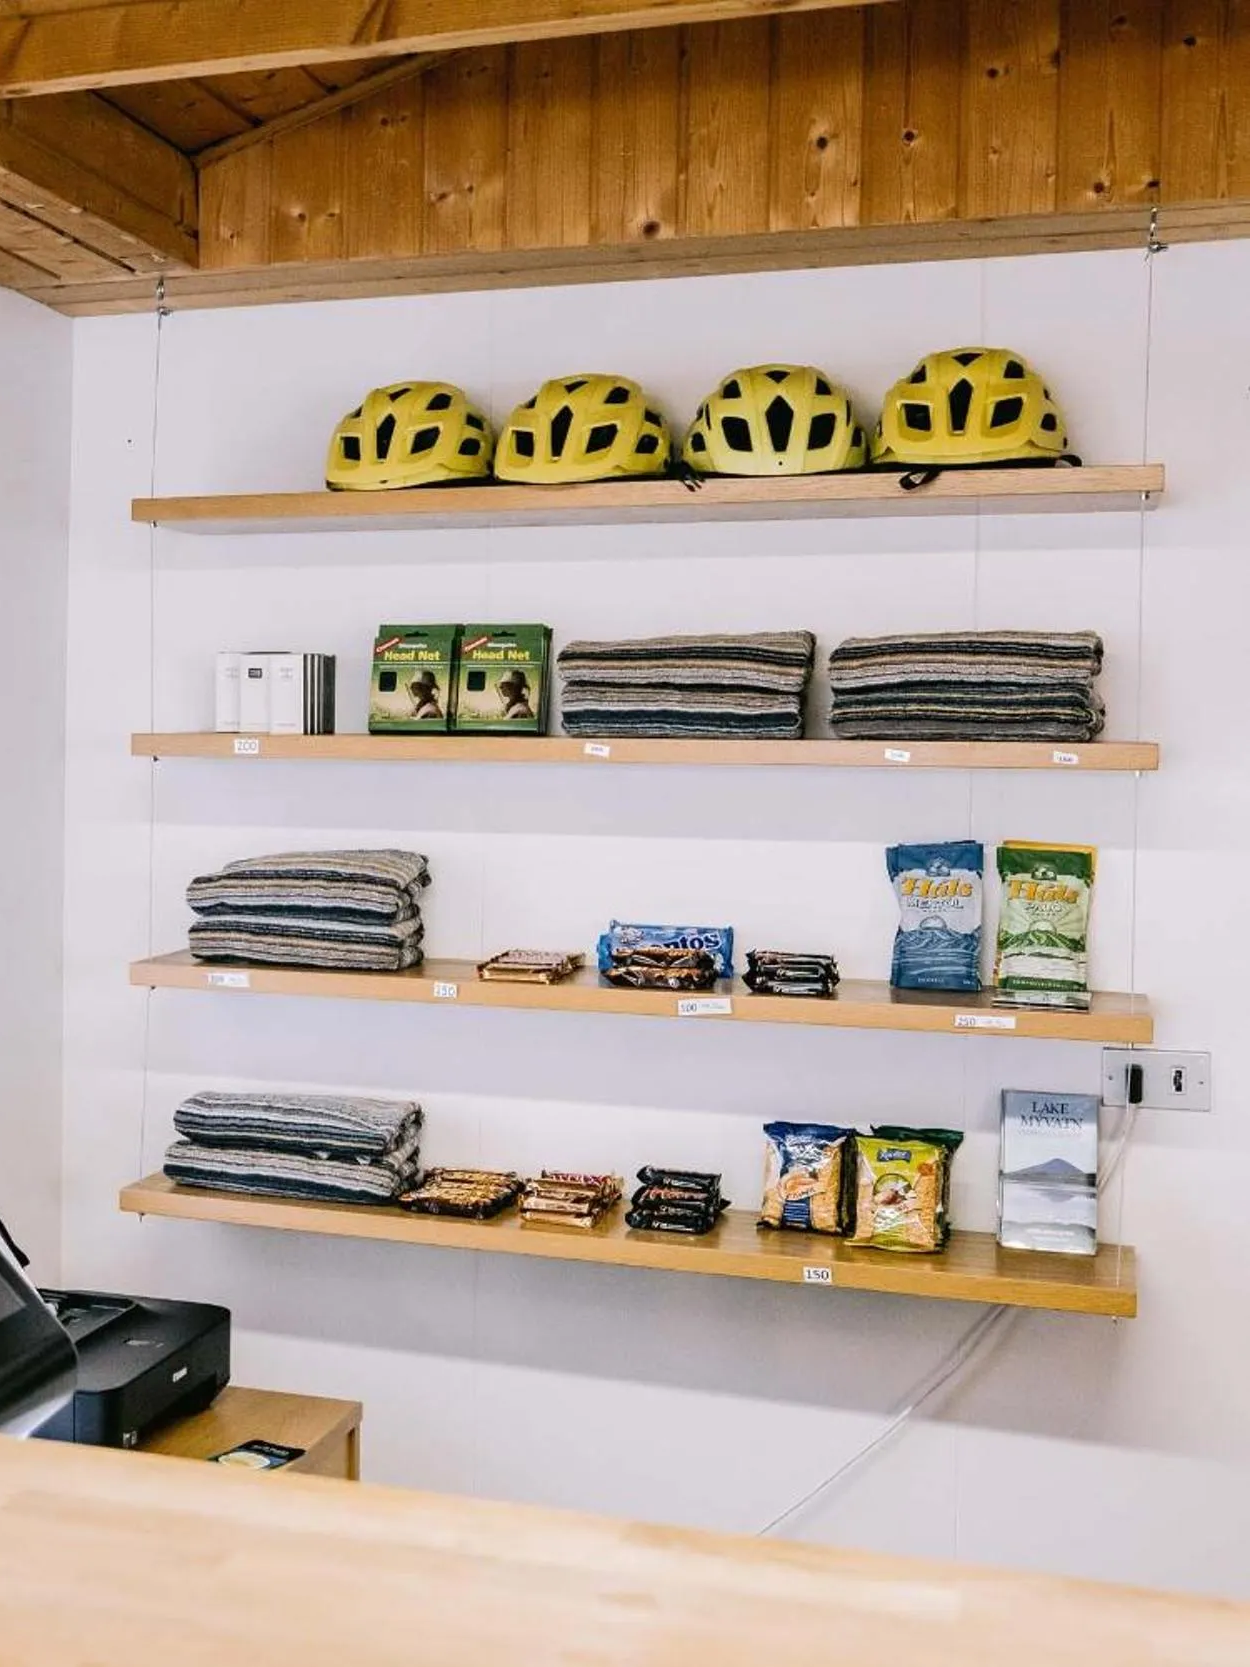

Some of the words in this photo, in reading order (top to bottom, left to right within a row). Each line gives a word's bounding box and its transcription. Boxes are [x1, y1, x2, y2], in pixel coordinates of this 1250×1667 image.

[384, 650, 415, 661] Head
[418, 651, 441, 661] Net
[472, 650, 504, 661] Head
[508, 651, 531, 661] Net
[1031, 1101, 1069, 1114] LAKE
[805, 1269, 829, 1280] 150
